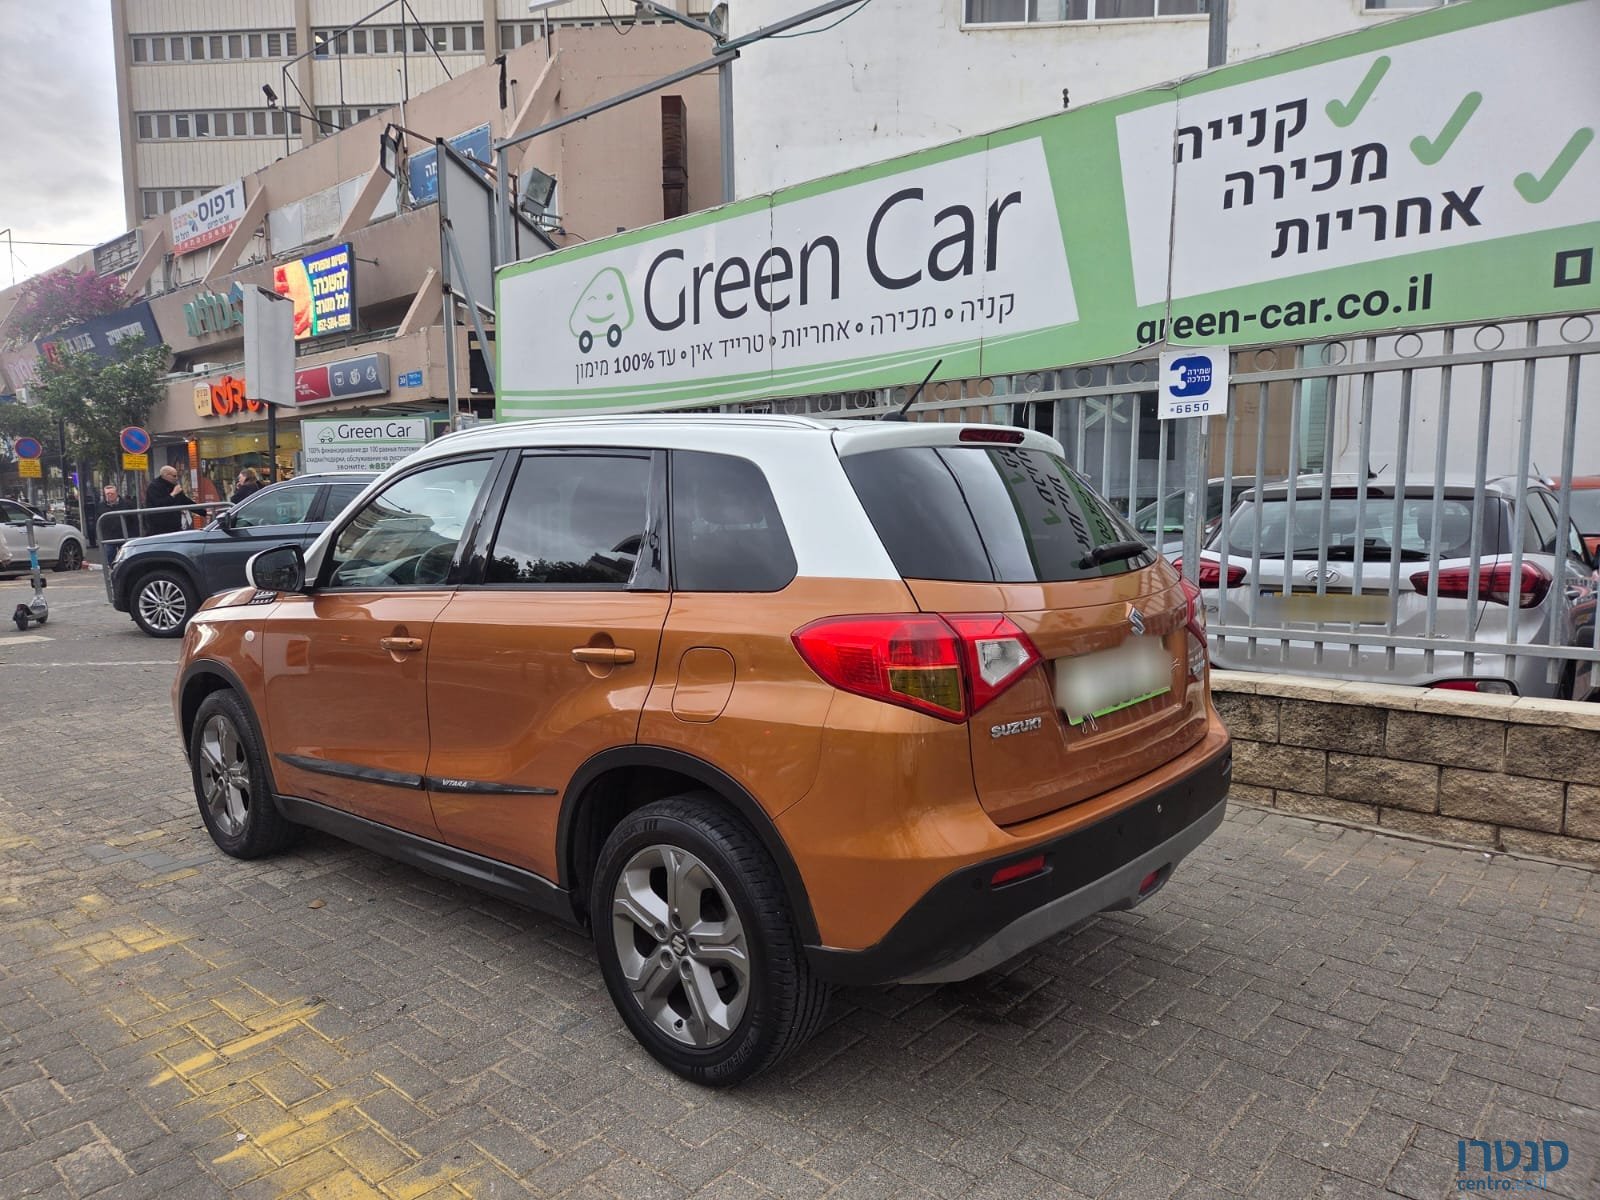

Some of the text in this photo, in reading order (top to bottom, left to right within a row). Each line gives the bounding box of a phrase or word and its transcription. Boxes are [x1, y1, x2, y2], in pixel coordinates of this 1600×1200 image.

[1175, 98, 1308, 164] קנייה
[1223, 142, 1388, 210] מכירה
[198, 188, 235, 222] דפוס
[1271, 185, 1485, 259] אחריות
[644, 187, 1022, 332] Green Car
[1136, 273, 1433, 348] green-car.co.il
[575, 293, 1014, 384] קניה מכירה אחריות טרייד אין עד 100% מימון
[1187, 367, 1211, 376] שמירה
[1187, 375, 1210, 383] כהלכה
[338, 423, 412, 439] Green Car
[991, 717, 1042, 739] SUZUKI
[442, 779, 468, 788] VITARA
